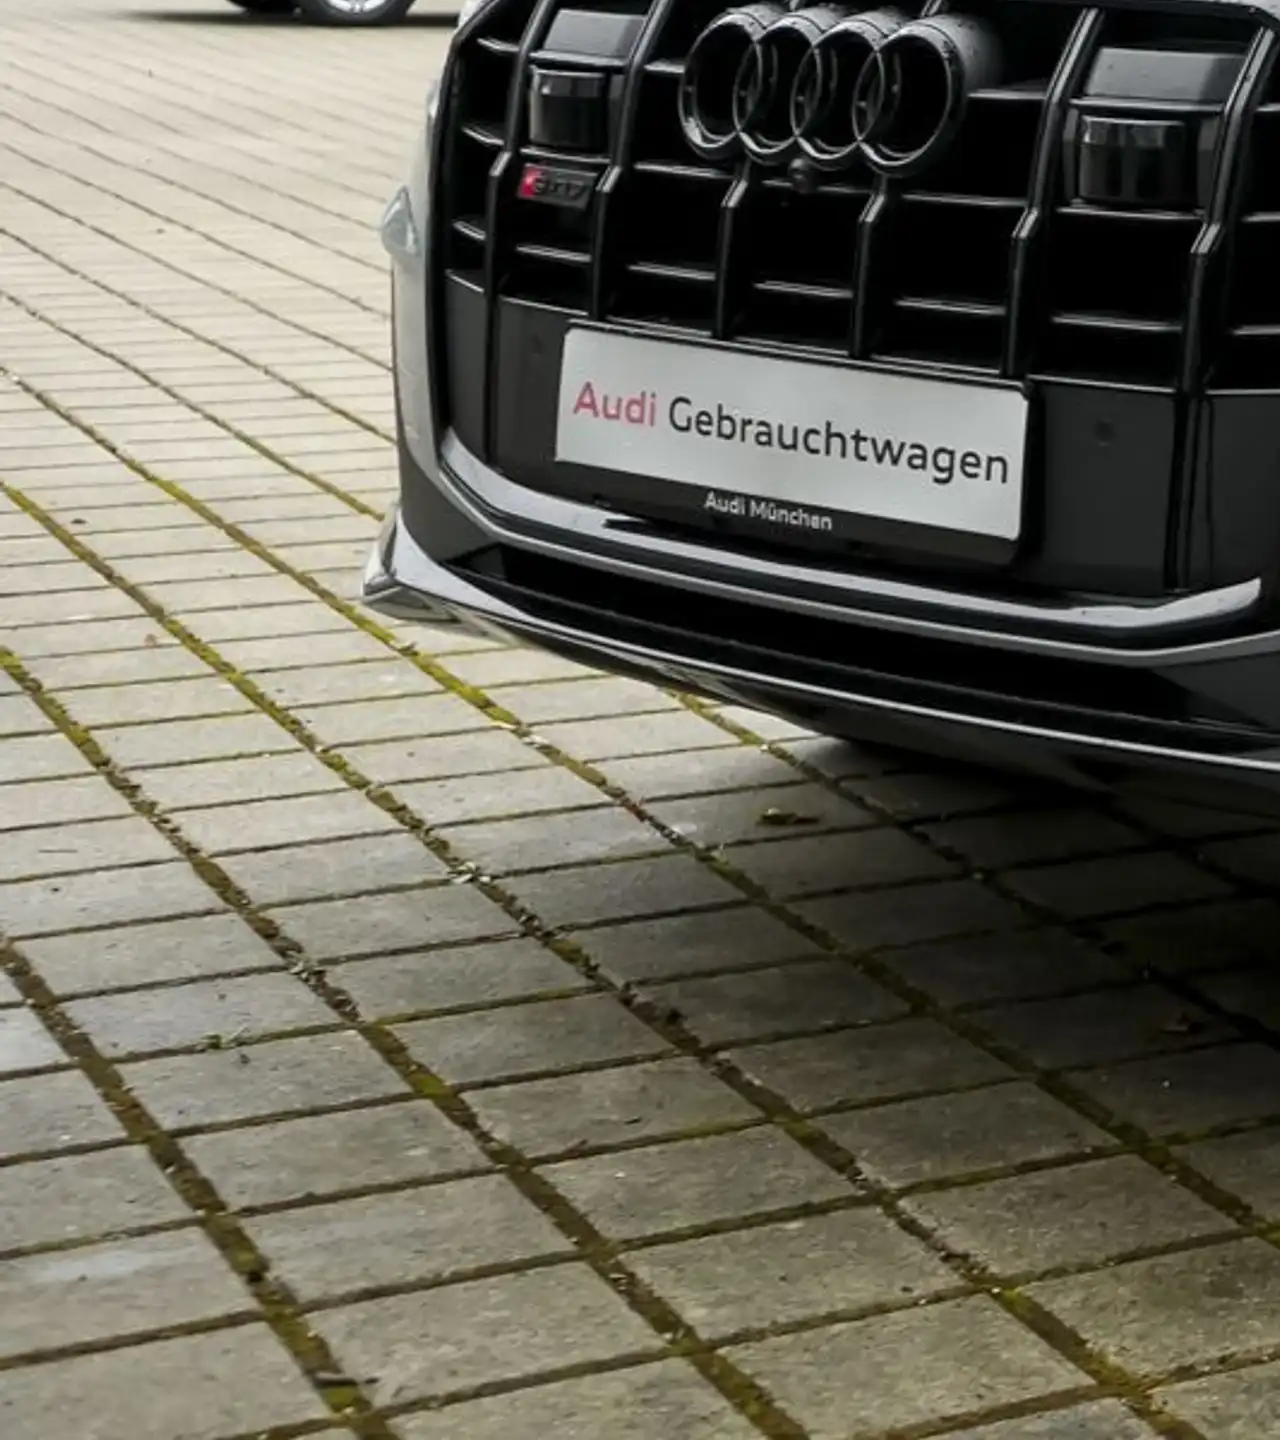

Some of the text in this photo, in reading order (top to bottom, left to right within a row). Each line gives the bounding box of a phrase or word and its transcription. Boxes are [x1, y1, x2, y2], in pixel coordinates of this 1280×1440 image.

[573, 381, 1008, 485] Audi Gebrauchtwagen
[704, 491, 832, 530] Audi München
